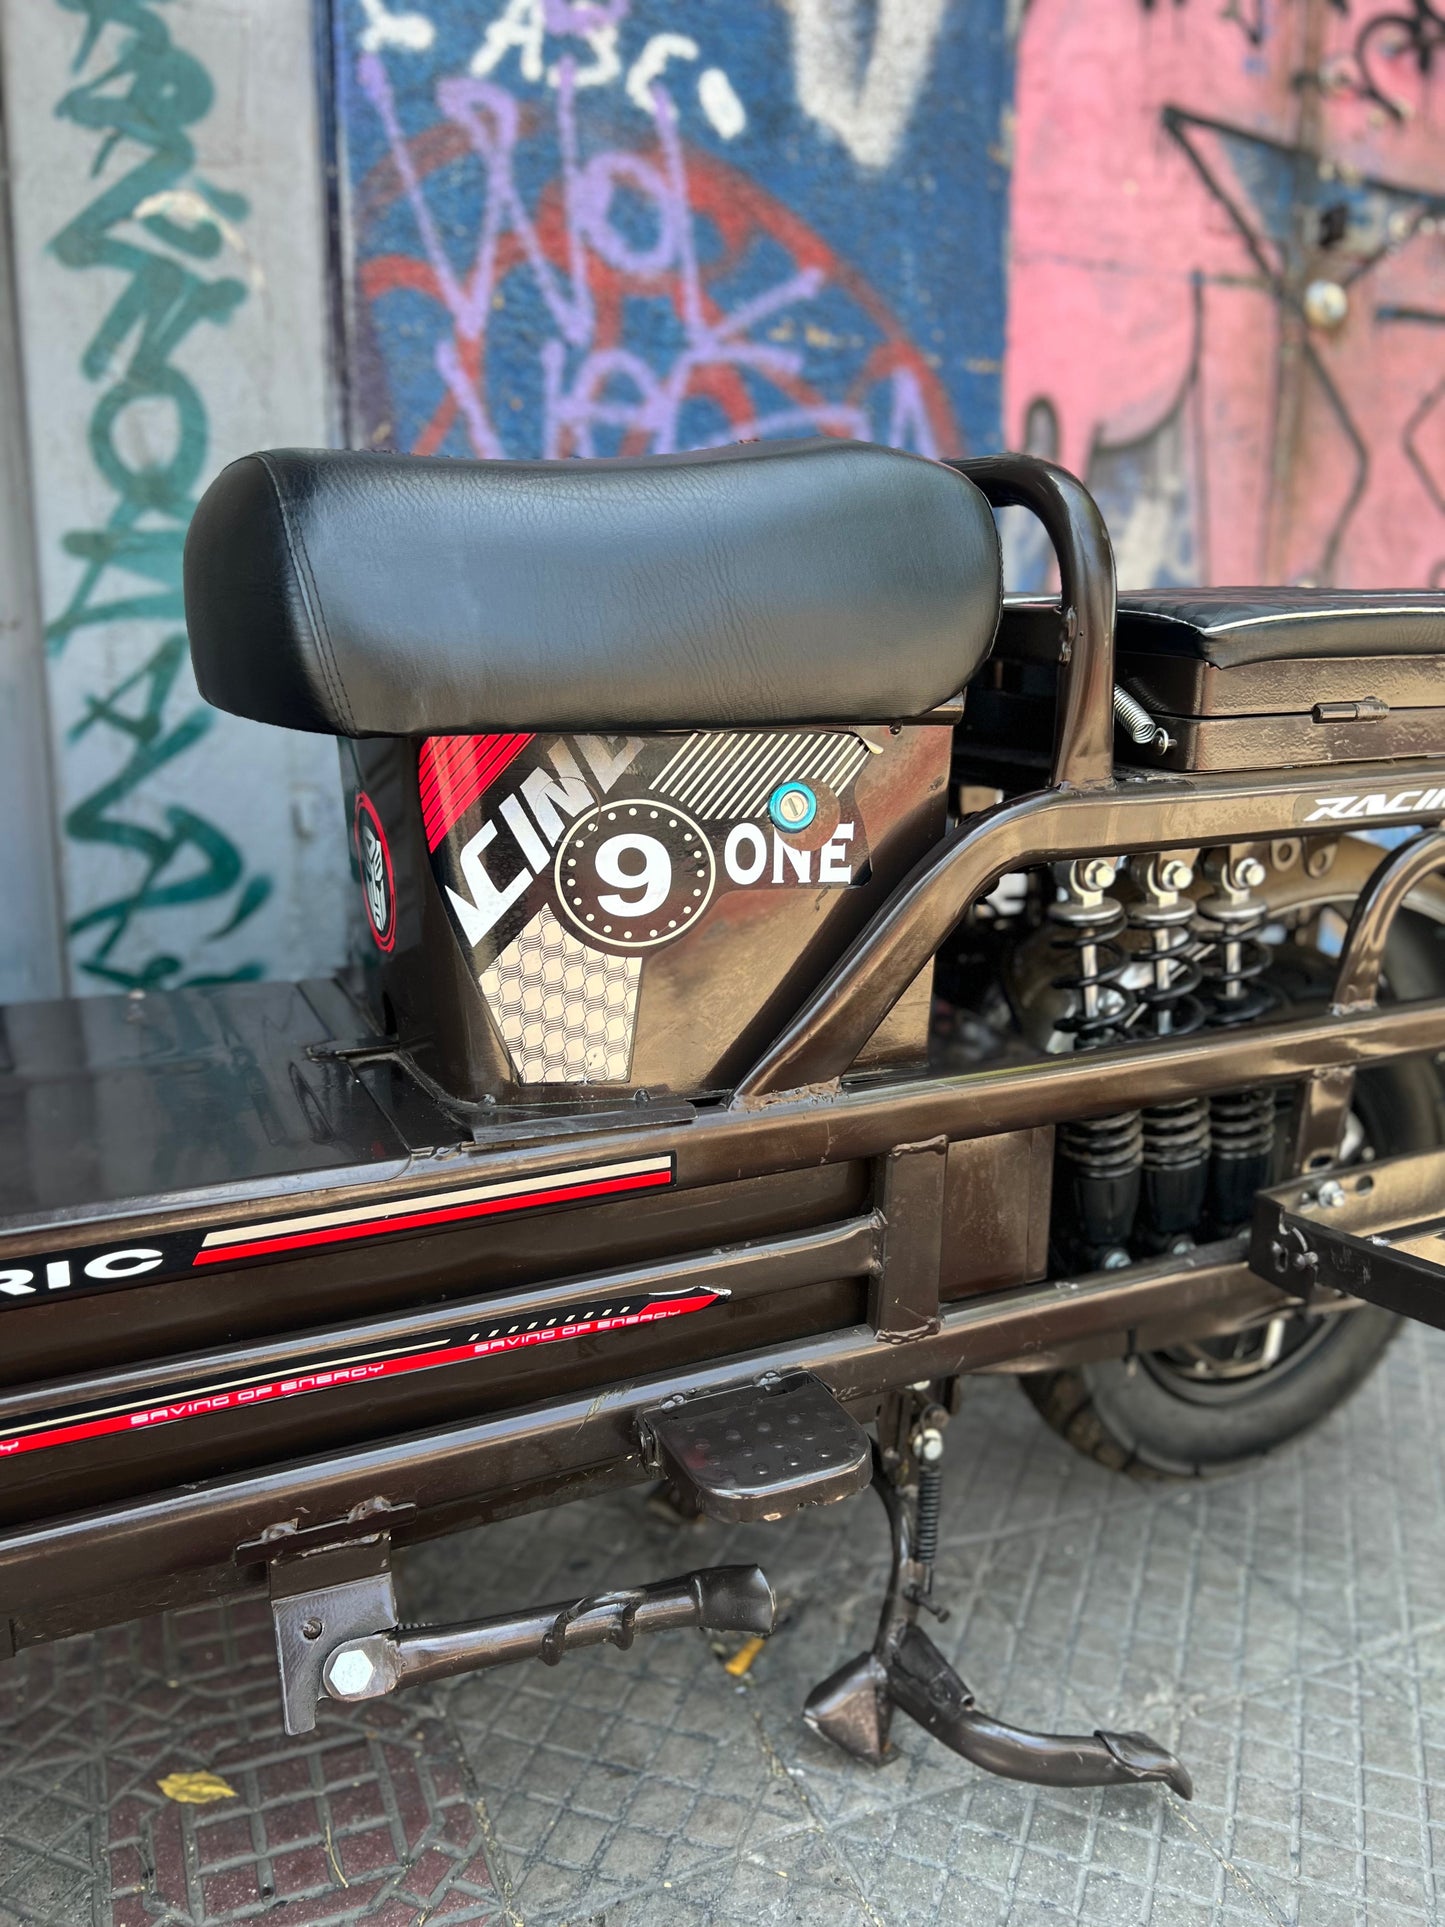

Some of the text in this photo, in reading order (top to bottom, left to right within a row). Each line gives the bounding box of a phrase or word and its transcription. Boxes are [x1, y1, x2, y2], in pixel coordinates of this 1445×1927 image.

[594, 833, 673, 918] 9
[724, 821, 855, 886] ONE
[474, 1309, 681, 1353] SAVING OF ENERGY
[130, 1363, 385, 1425] SAVING OF ENERGY
